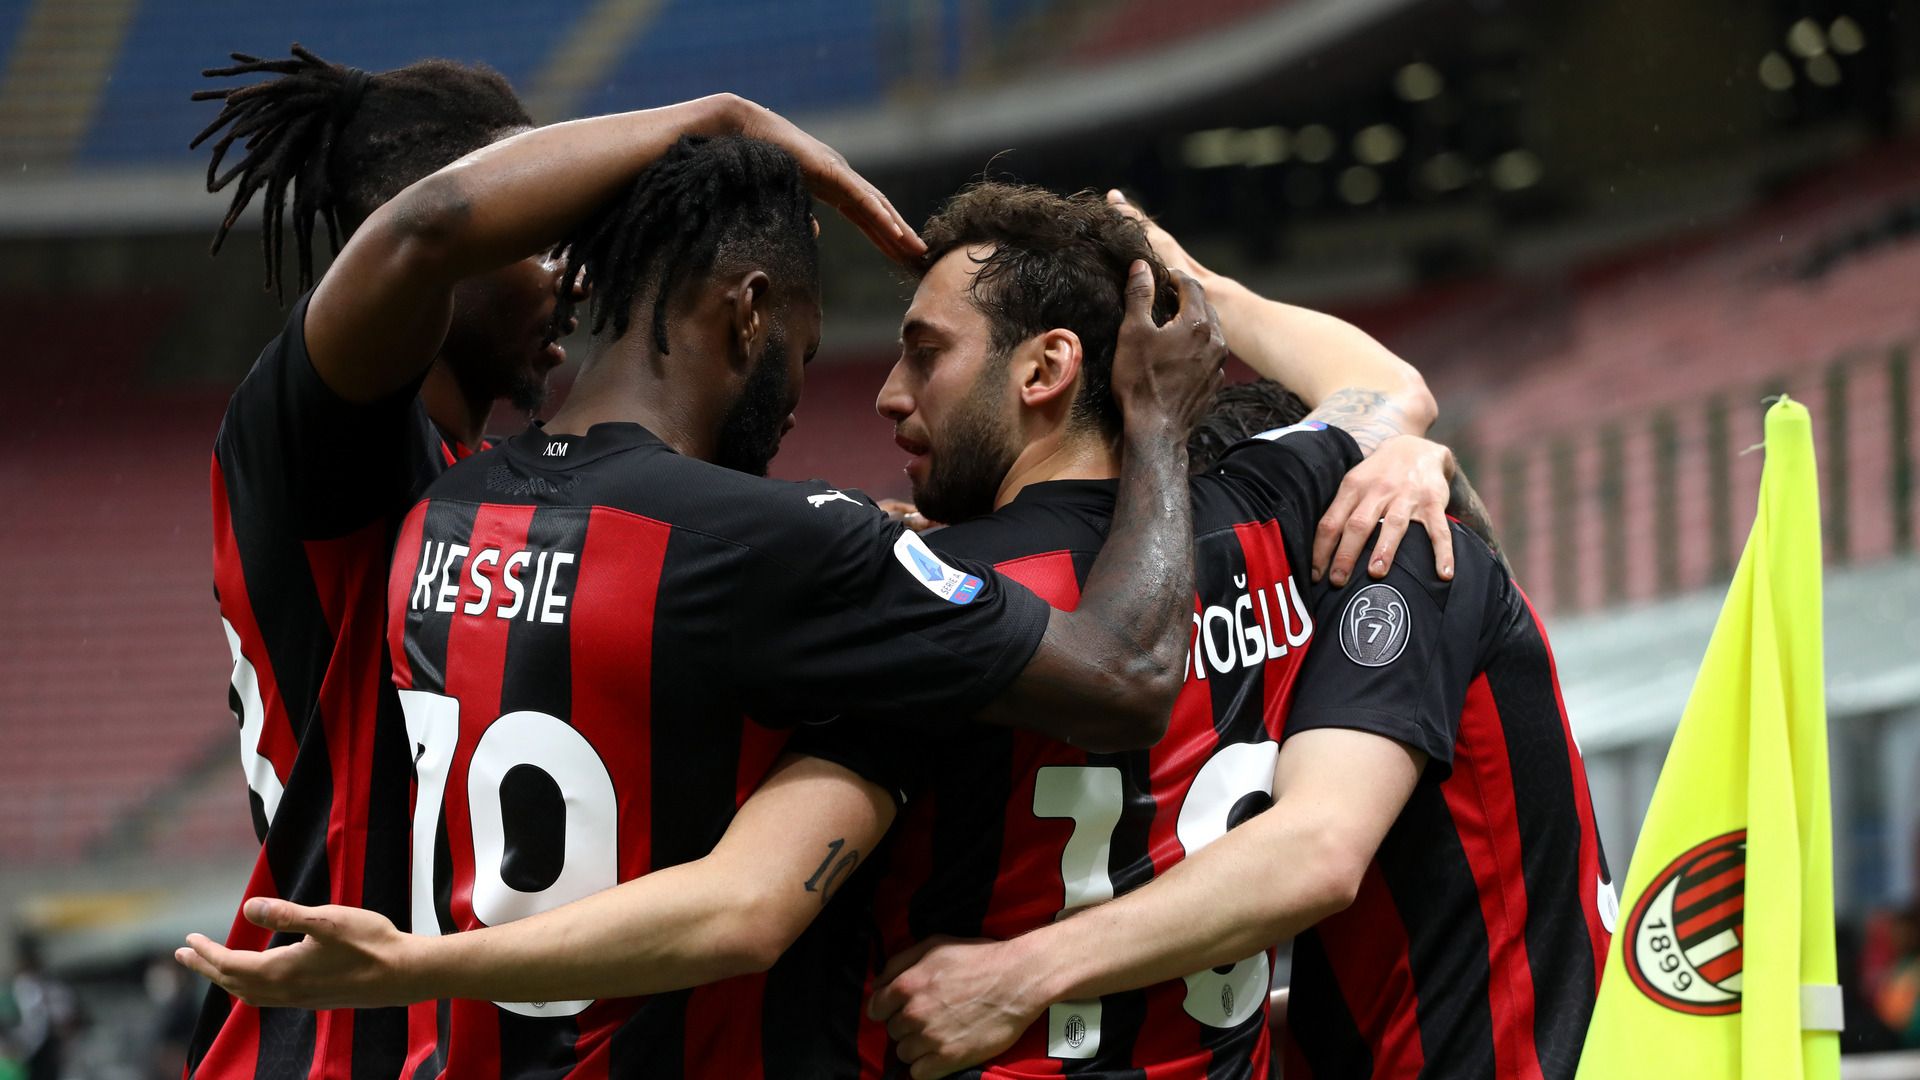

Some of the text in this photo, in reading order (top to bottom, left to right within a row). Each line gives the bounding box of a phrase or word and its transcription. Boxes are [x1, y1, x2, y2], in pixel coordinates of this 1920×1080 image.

[542, 442, 569, 457] ACM
[411, 540, 575, 624] KESSIE
[1366, 623, 1384, 644] 7
[1647, 917, 1693, 992] 1899
